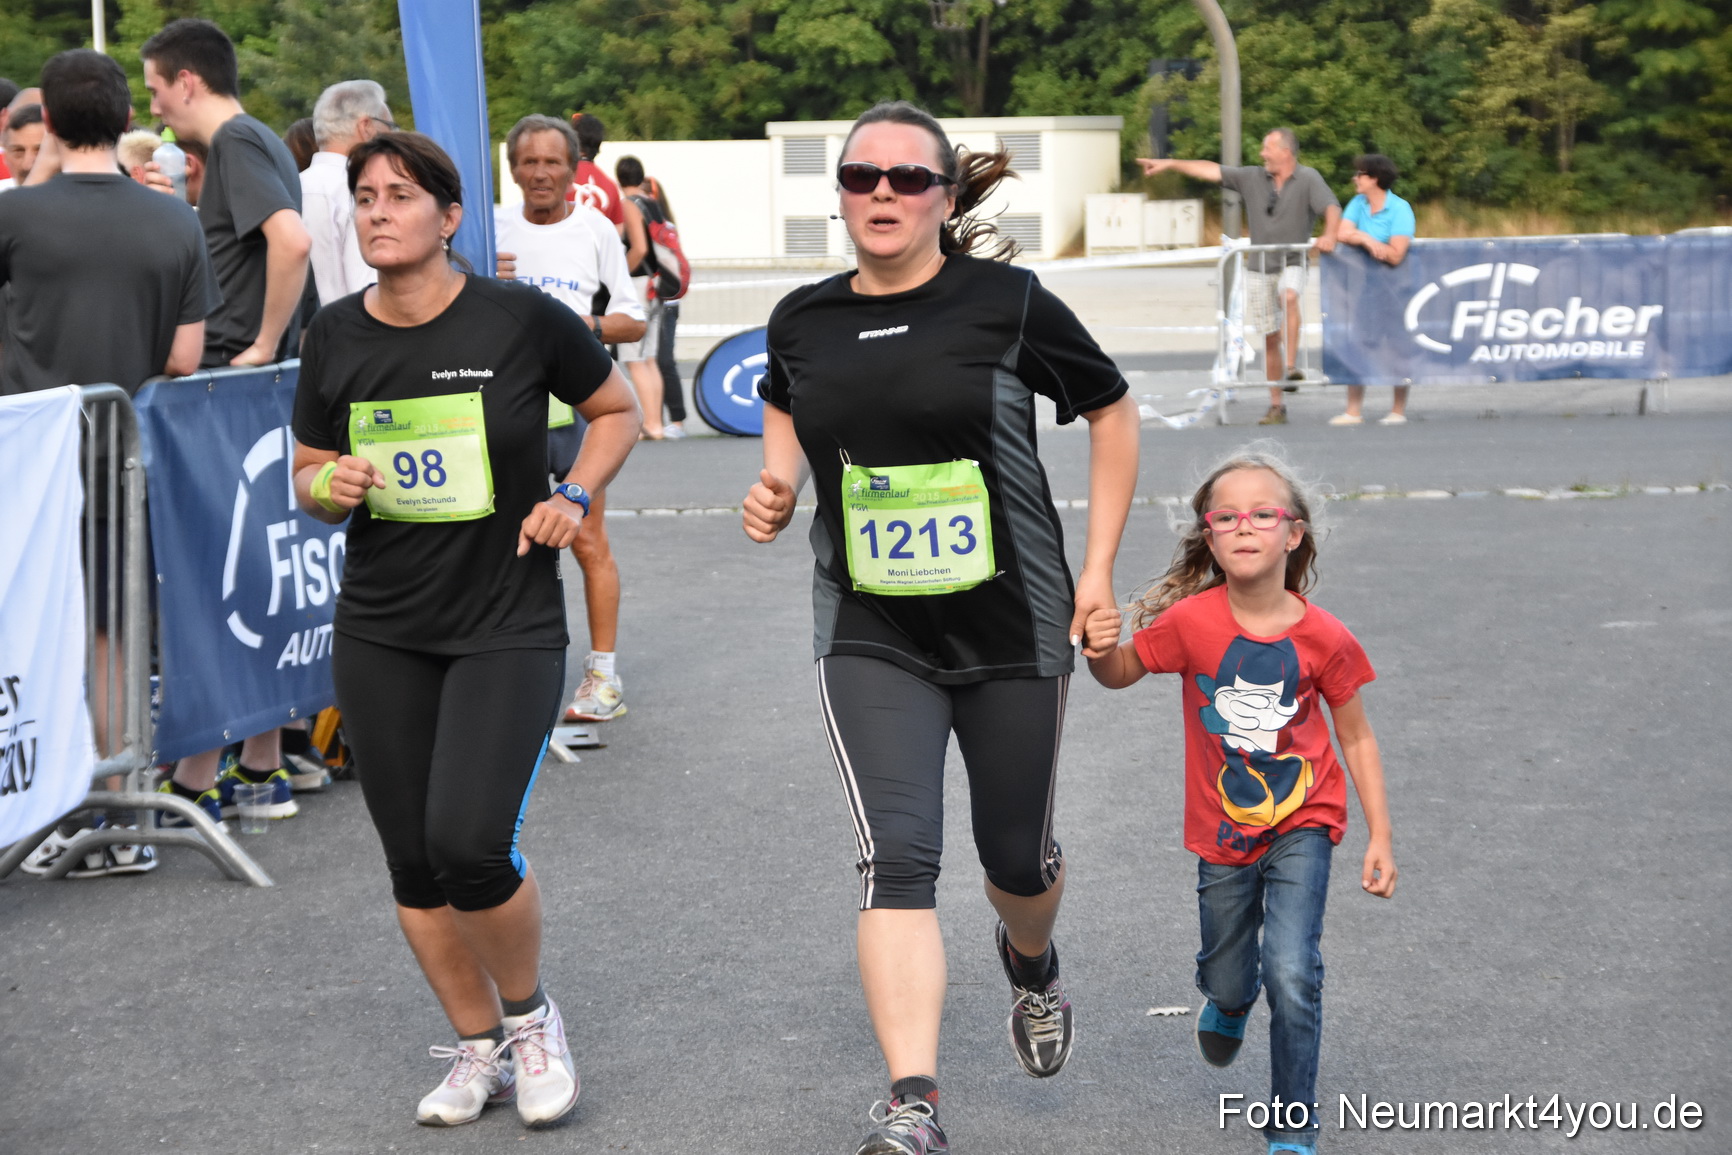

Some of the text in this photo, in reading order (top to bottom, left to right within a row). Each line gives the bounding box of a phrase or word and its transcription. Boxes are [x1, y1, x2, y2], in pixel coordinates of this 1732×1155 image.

[1451, 297, 1663, 341] Fischer
[1470, 341, 1646, 363] AUTOMOBILE
[431, 368, 494, 380] Evelyn Schunda
[367, 420, 412, 432] firmenlauf
[393, 449, 447, 489] 98
[396, 496, 457, 506] Evelyn Schunda
[861, 488, 910, 499] firmenlauf
[860, 515, 977, 559] 1213
[887, 567, 951, 577] Moni Liebchen
[276, 622, 334, 670] AUT
